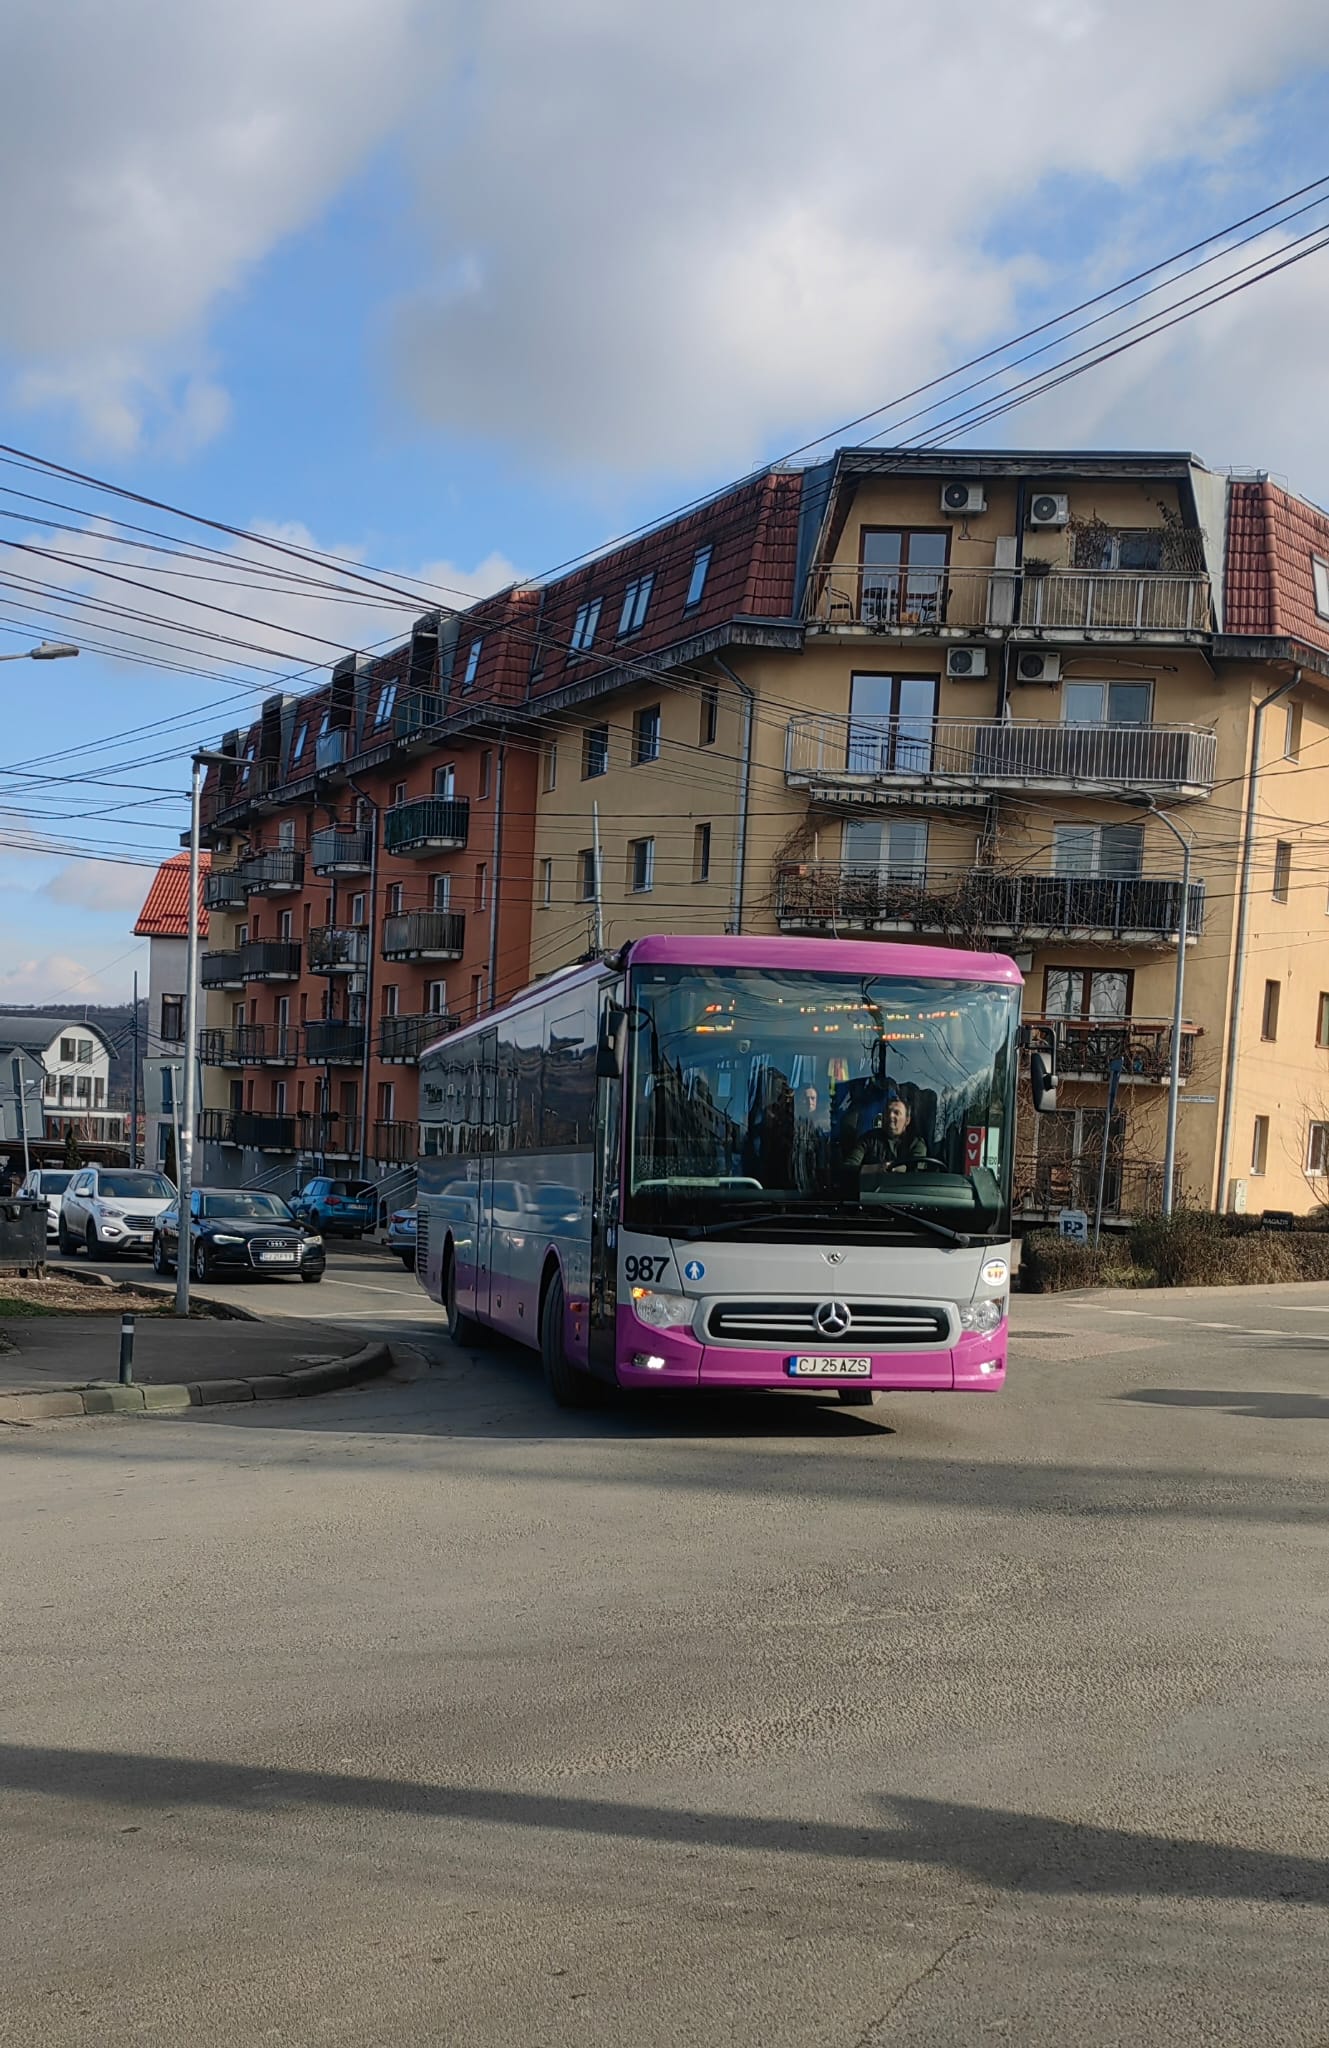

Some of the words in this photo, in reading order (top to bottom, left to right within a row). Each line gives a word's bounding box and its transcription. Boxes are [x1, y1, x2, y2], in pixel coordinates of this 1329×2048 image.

[625, 1255, 670, 1283] 987
[799, 1358, 817, 1372] CJ
[821, 1359, 837, 1372] 25
[839, 1359, 868, 1373] AZS
